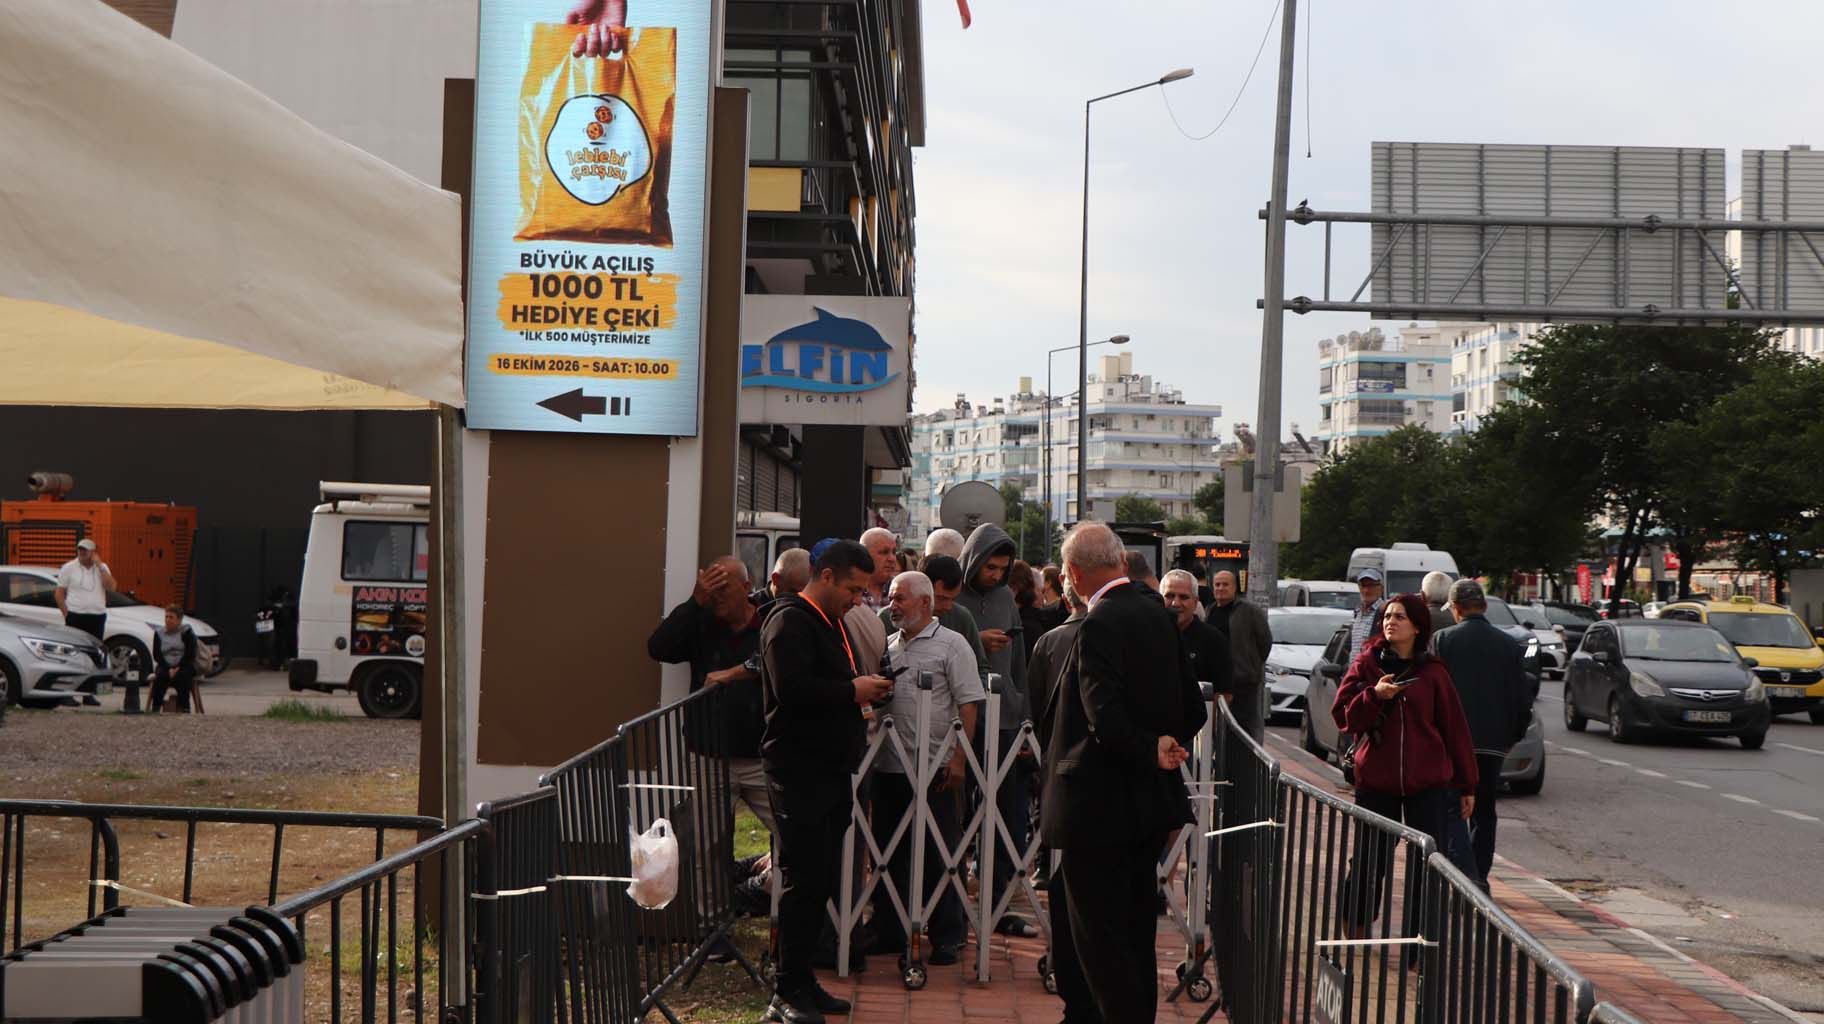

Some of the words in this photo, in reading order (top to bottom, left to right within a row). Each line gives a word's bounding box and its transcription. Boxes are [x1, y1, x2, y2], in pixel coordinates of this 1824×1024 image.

[566, 147, 628, 167] leblebi
[520, 249, 588, 270] BÜYÜK
[592, 255, 655, 277] AÇILIŞ
[529, 273, 604, 299] 1000
[610, 277, 644, 301] TL
[511, 301, 598, 326] HEDİYE
[603, 304, 660, 332] ÇEKİ
[546, 331, 568, 342] 500
[570, 331, 651, 346] MÜŞTERİMİZE
[497, 358, 510, 370] 16
[513, 357, 546, 371] EKİM
[548, 359, 580, 372] 2026
[592, 361, 632, 374] SAAT:
[635, 362, 670, 375] 10.00
